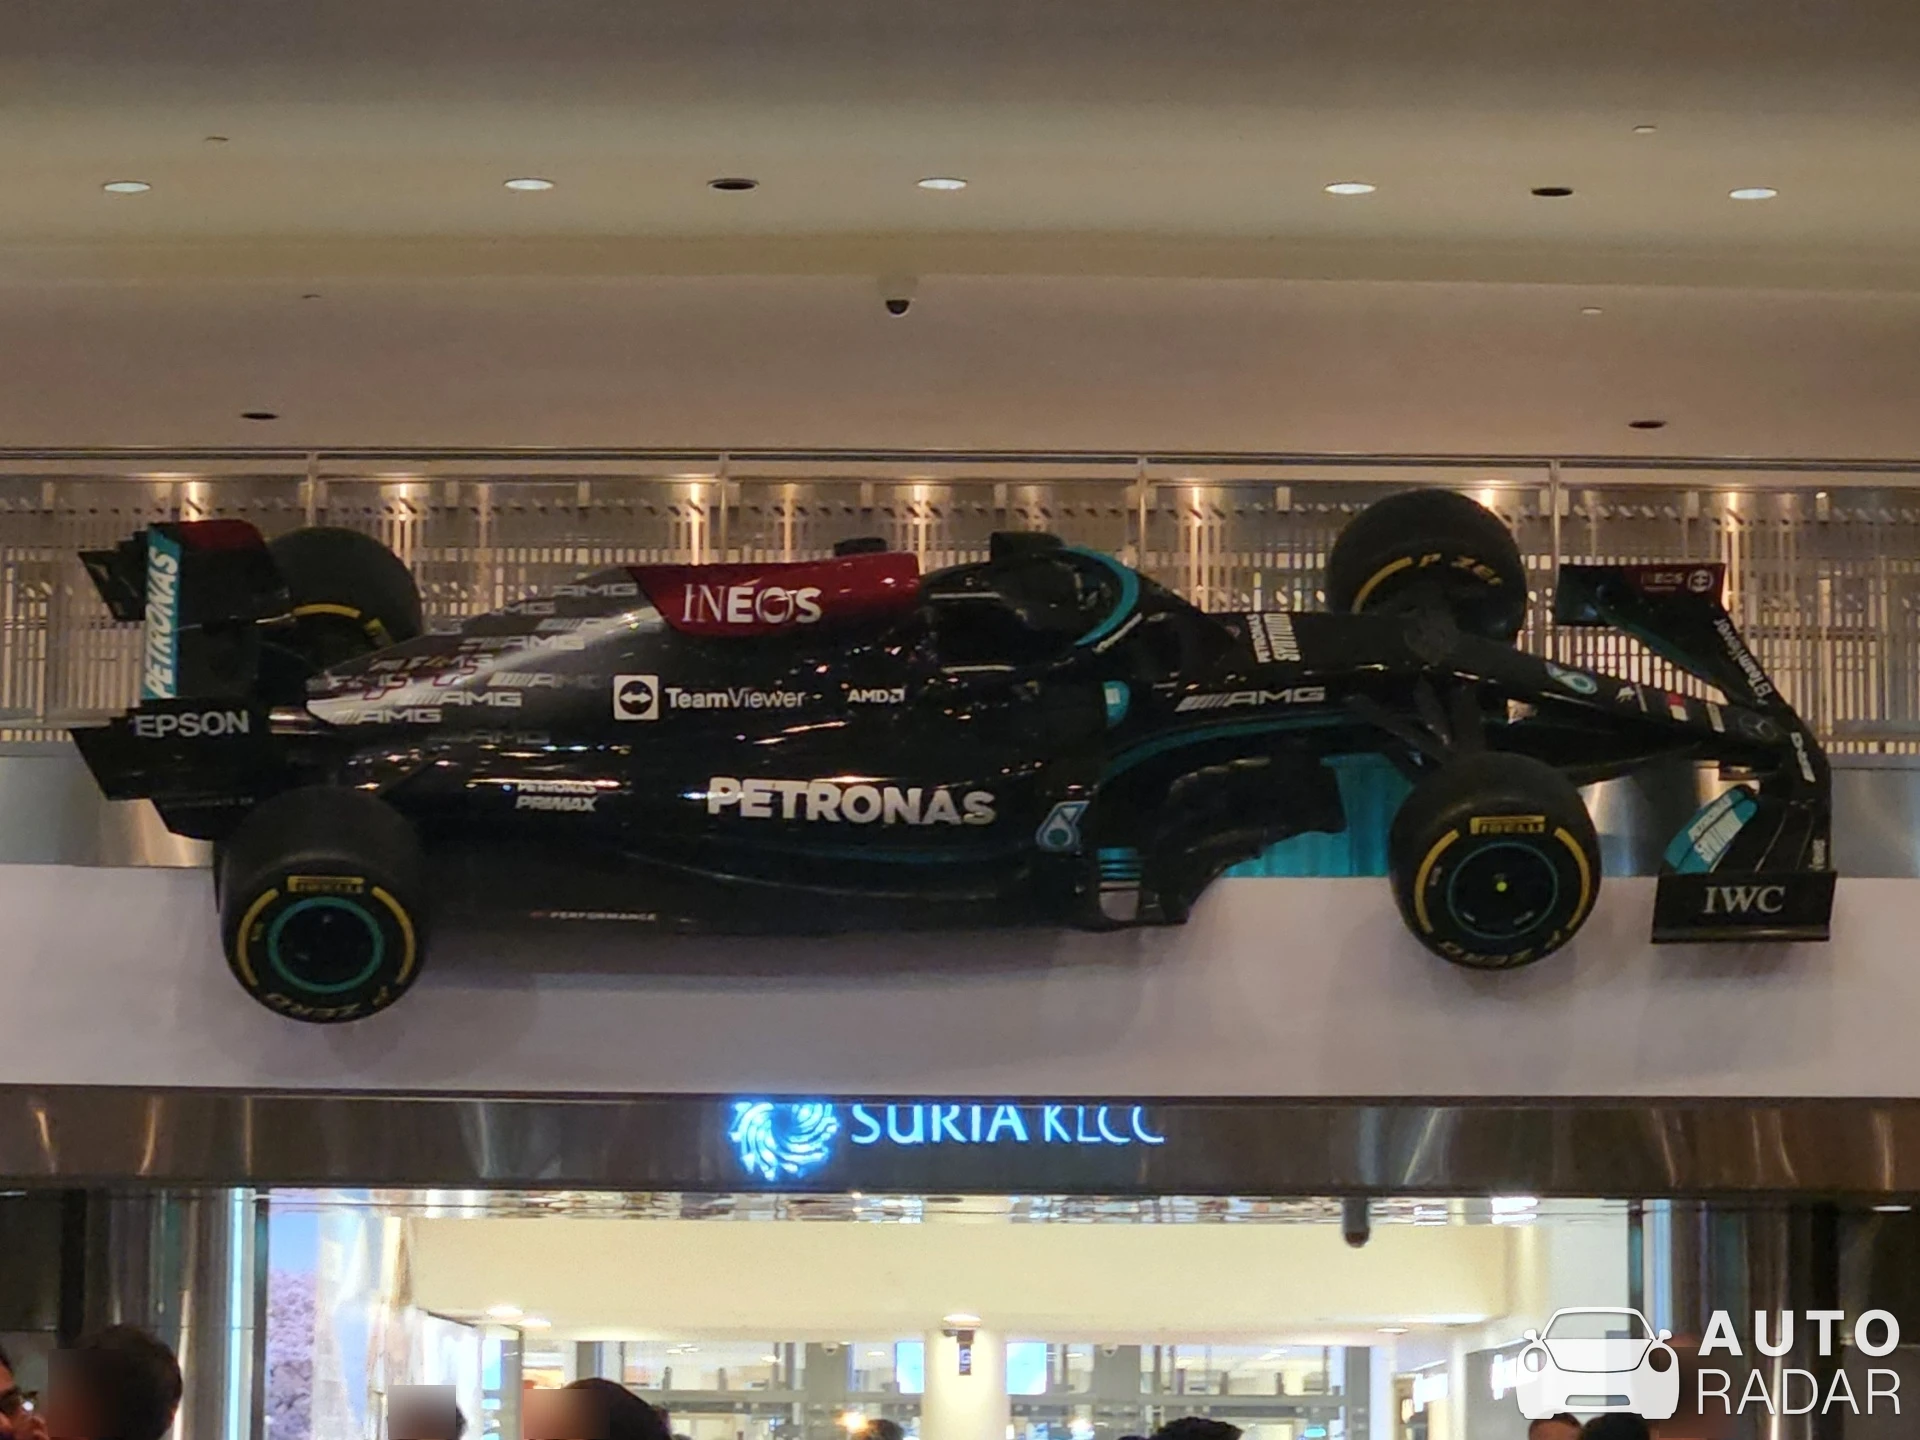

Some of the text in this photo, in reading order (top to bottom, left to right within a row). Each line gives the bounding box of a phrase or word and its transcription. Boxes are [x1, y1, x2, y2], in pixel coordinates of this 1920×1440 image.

[682, 583, 822, 624] INEOS
[145, 546, 178, 699] PETRONAS
[438, 692, 523, 708] AMG
[665, 687, 807, 709] TeamViewer
[847, 688, 889, 703] AMD
[1223, 686, 1325, 707] AMG
[136, 710, 250, 739] EPSON
[356, 708, 442, 724] AMG
[707, 776, 996, 826] PETRONAS
[1703, 885, 1786, 914] IWC
[851, 1104, 1166, 1143] SURIA KLCC
